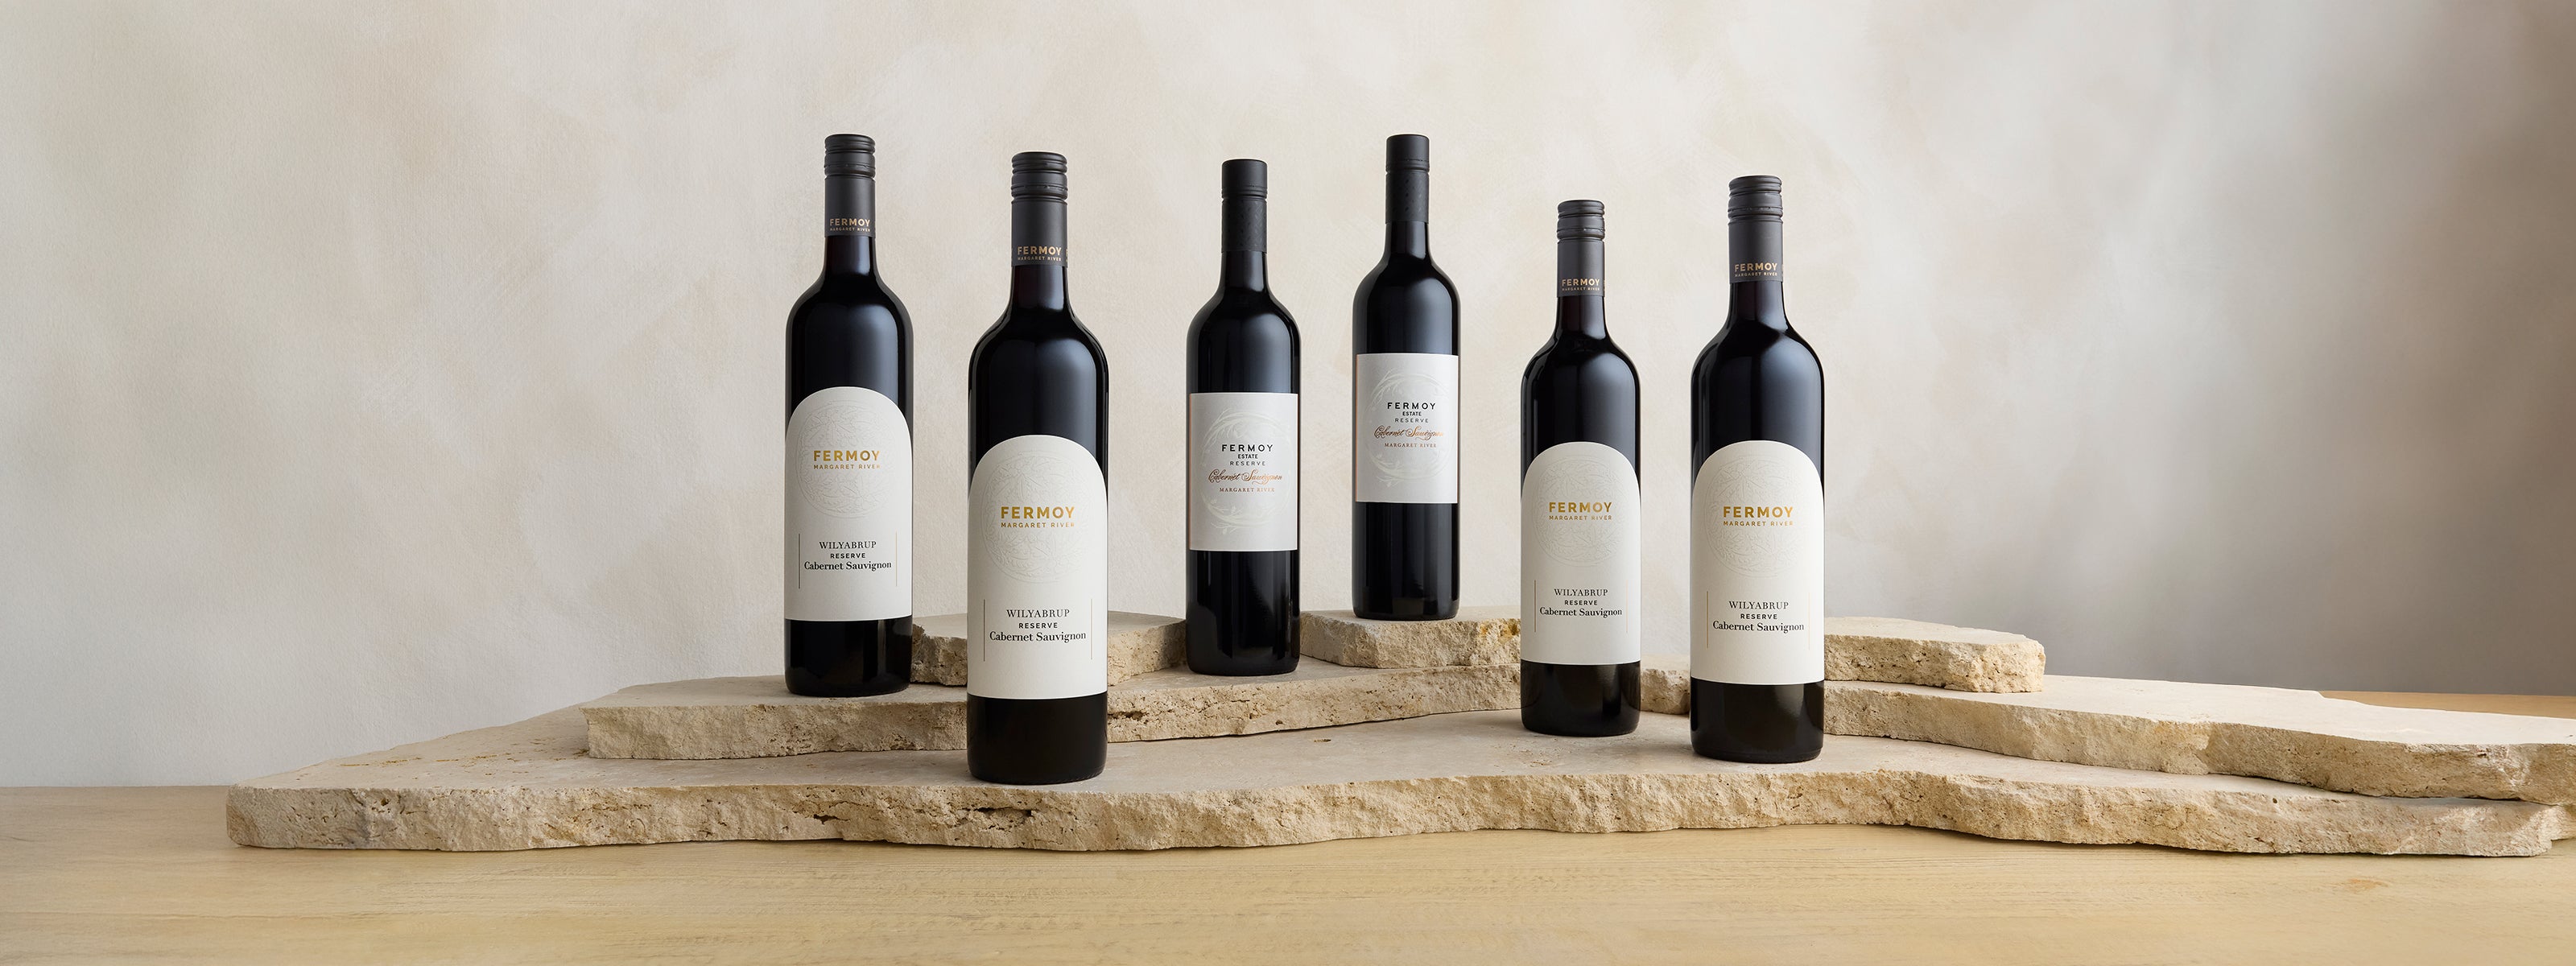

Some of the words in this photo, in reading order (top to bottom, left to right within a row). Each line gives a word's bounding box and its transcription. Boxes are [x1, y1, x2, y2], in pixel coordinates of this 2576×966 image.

[830, 218, 870, 226] FERMOY
[1018, 246, 1061, 255] FERMOY
[1735, 262, 1777, 272] FERMOY
[1374, 425, 1404, 440] Cabernet
[813, 450, 881, 461] FERMOY
[1208, 469, 1241, 483] Cabernet
[1241, 469, 1282, 485] Sauvignon
[1001, 506, 1075, 519] FERMOY
[1549, 502, 1612, 513] FERMOY
[1723, 506, 1794, 518] FERMOY
[819, 541, 876, 549] WILYABRUP
[804, 561, 844, 570] Cabernet
[846, 561, 892, 572] Sauvignon
[1554, 588, 1608, 597] WILYABRUP
[1729, 601, 1789, 609] WILYABRUP
[1006, 609, 1070, 617] WILYABRUP
[1539, 607, 1577, 616] Cabernet
[1579, 608, 1622, 618] Sauvignon
[1713, 621, 1754, 631] Cabernet
[1757, 621, 1804, 634] Sauvignon
[989, 631, 1034, 642] Cabernet
[1036, 631, 1086, 643] Sauvignon
